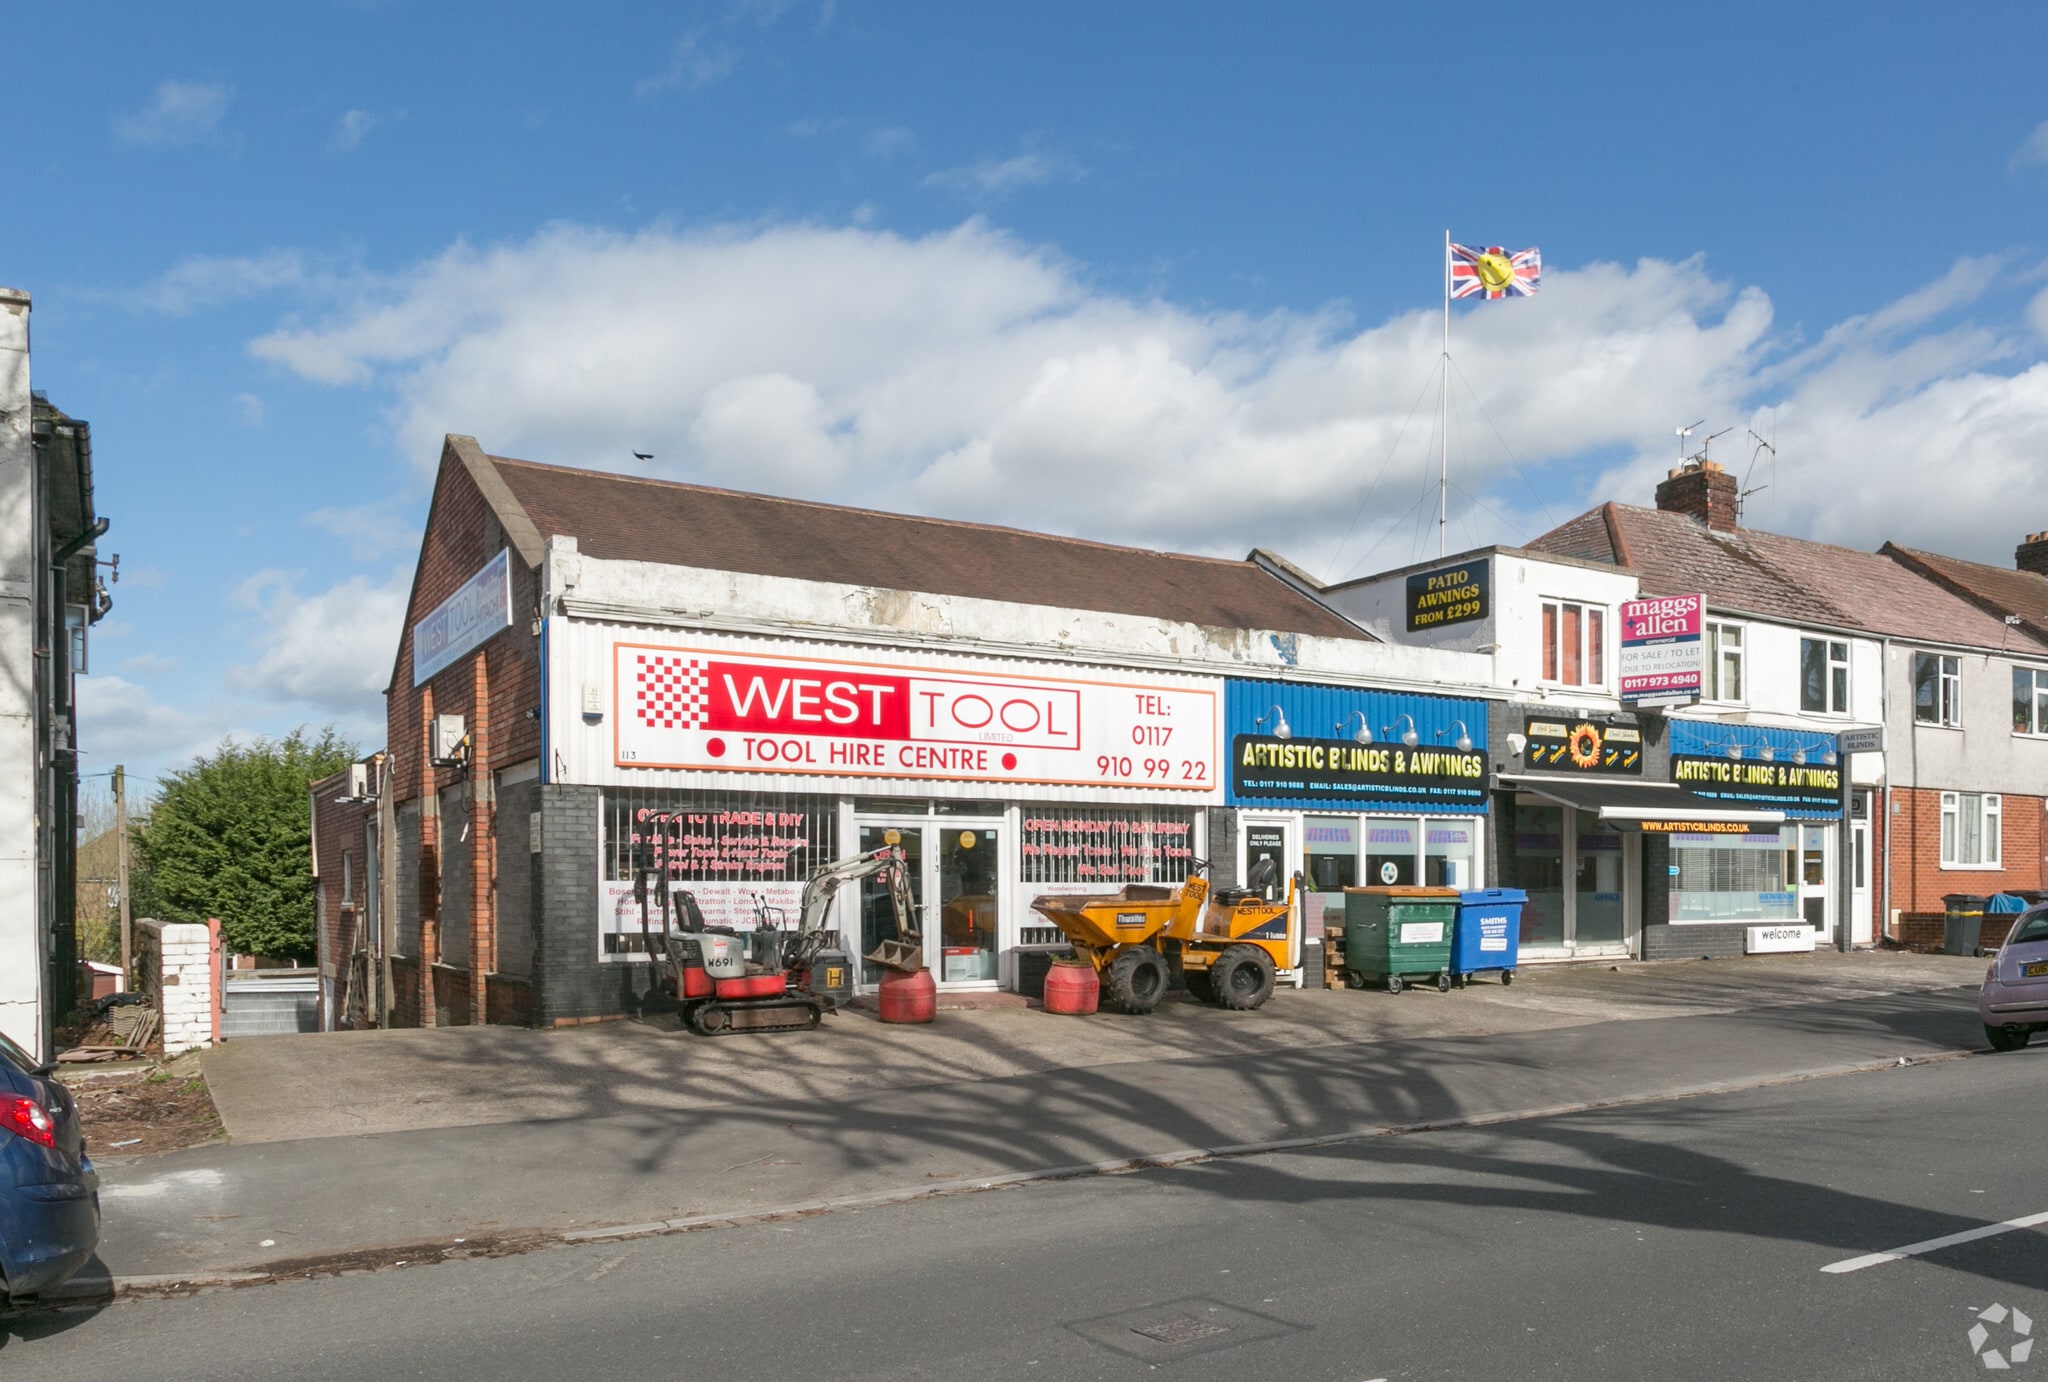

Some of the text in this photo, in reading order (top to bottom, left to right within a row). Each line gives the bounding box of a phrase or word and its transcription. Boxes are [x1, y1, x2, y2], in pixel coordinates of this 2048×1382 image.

[1428, 570, 1468, 590] PATIO
[1418, 584, 1479, 608] AWNINGS
[1415, 600, 1480, 624] FROM £299
[1627, 597, 1698, 618] maggs
[422, 611, 448, 656] WEST
[450, 593, 474, 637] TOOL
[1636, 616, 1688, 636] allen
[1622, 653, 1638, 662] FOR
[1642, 650, 1662, 660] SALE
[1671, 649, 1682, 657] TO
[1686, 647, 1700, 656] LET
[1653, 660, 1700, 670] RELOCATION)
[1624, 674, 1697, 688] 0117 973 4940
[1623, 688, 1700, 699] www.maggsandallen.co.uk
[723, 674, 1067, 736] WEST TOOL
[1136, 694, 1171, 716] TEL:
[979, 732, 1013, 742] LIMITED
[1132, 725, 1173, 746] 0117
[1845, 732, 1879, 740] ARTISTIC
[622, 751, 636, 760] 113
[743, 738, 987, 770] TOOL HIRE CENTRE
[1242, 742, 1482, 778] ARTISTIC BLINDS & AWNINGS
[1097, 756, 1206, 780] 910 99 22
[1676, 760, 1838, 789] ARTISTIC BLINDS & AWNINGS
[712, 812, 762, 826] TRADE
[764, 814, 776, 826] &
[779, 814, 804, 826] DIY
[1025, 818, 1190, 834] OPEN MONDAY TO SATURDAY
[1642, 822, 1750, 832] WWW.ARTISTICBLINDS.CO.UK
[652, 834, 674, 844] Hie
[683, 834, 712, 845] Sales
[721, 835, 759, 846] Service
[771, 836, 809, 848] Repairs
[654, 846, 689, 858] Pwer
[691, 847, 719, 858] Tools
[761, 848, 788, 858] Tools
[1022, 843, 1040, 856] We
[1043, 844, 1079, 857] Repair
[1082, 844, 1112, 856] Tools
[1121, 845, 1137, 856] We
[1164, 846, 1192, 858] Tools
[654, 859, 689, 870] Ptrol
[701, 860, 708, 870] 2
[710, 860, 744, 870] Stroke
[746, 860, 787, 872] Engines
[1078, 864, 1151, 876] We Sell Tools
[1188, 882, 1206, 893] WEST
[1186, 890, 1204, 901] TOOL
[1594, 893, 1620, 902] OFFICE
[1480, 916, 1507, 925] SMITHS
[1762, 928, 1801, 940] welcome
[708, 958, 733, 967] W691
[830, 970, 842, 986] H
